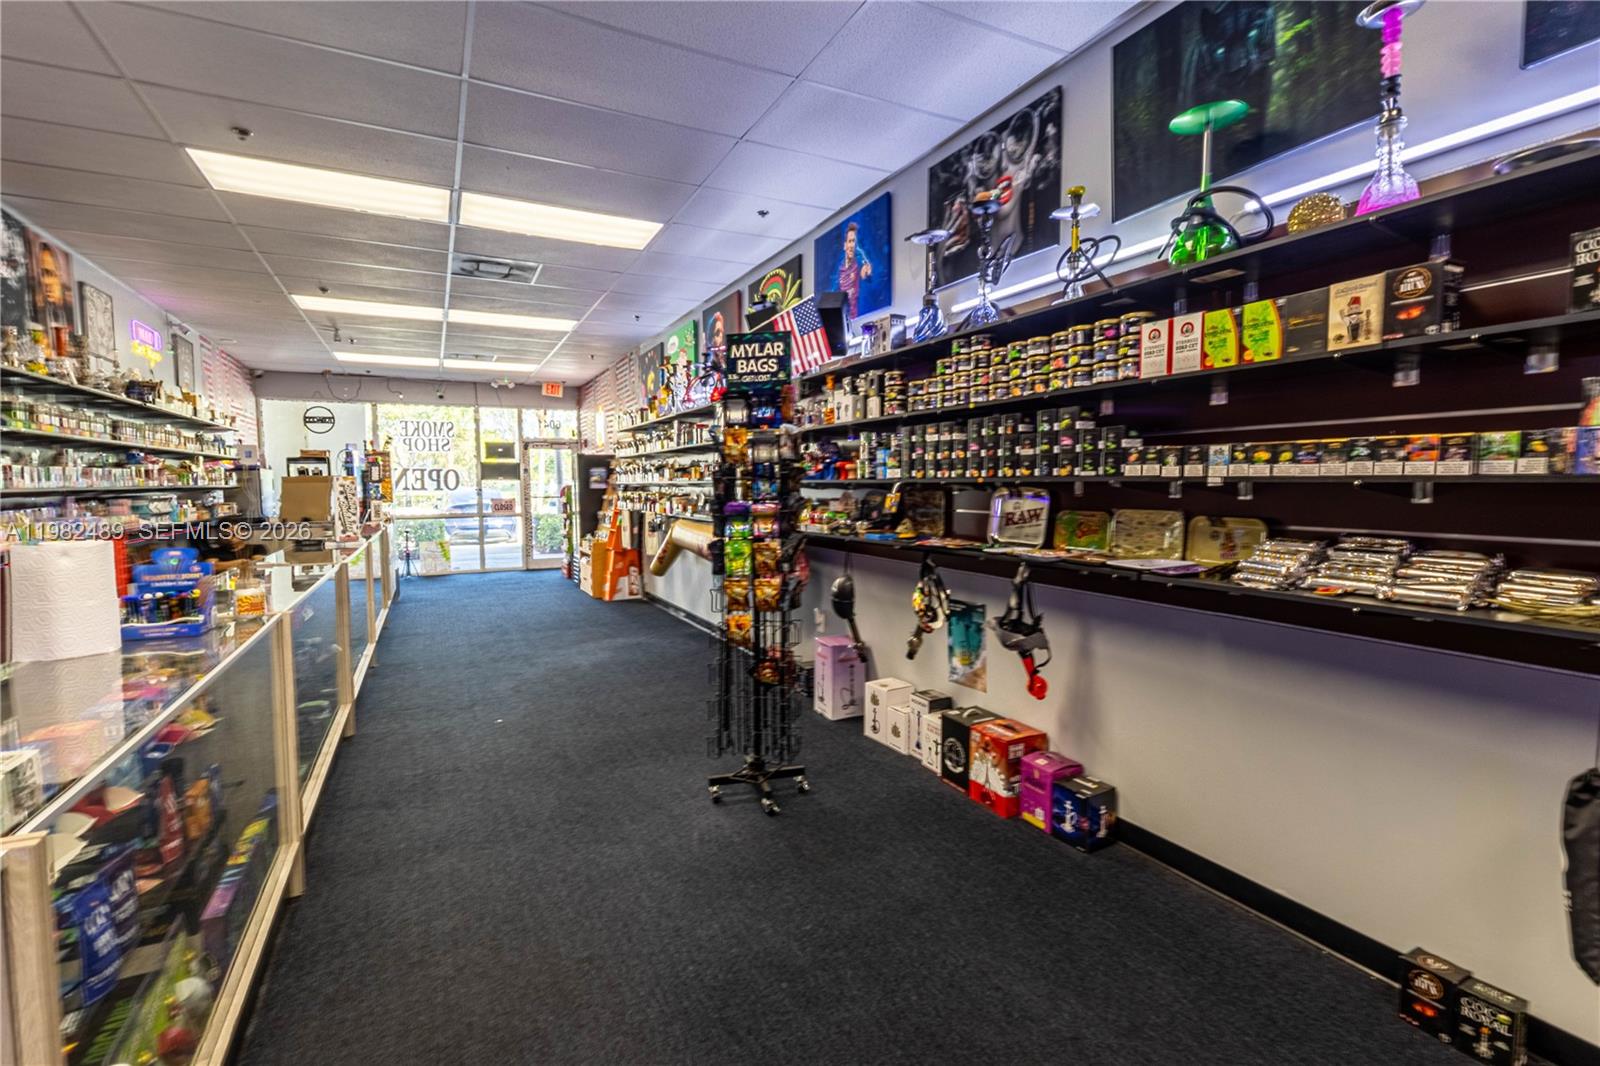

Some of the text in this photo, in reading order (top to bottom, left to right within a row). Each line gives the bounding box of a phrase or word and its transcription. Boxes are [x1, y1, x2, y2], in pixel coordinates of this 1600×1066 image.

[731, 342, 784, 358] MYLAR
[738, 359, 778, 373] BAGS
[546, 383, 560, 395] EXIT
[1004, 507, 1044, 526] RAW
